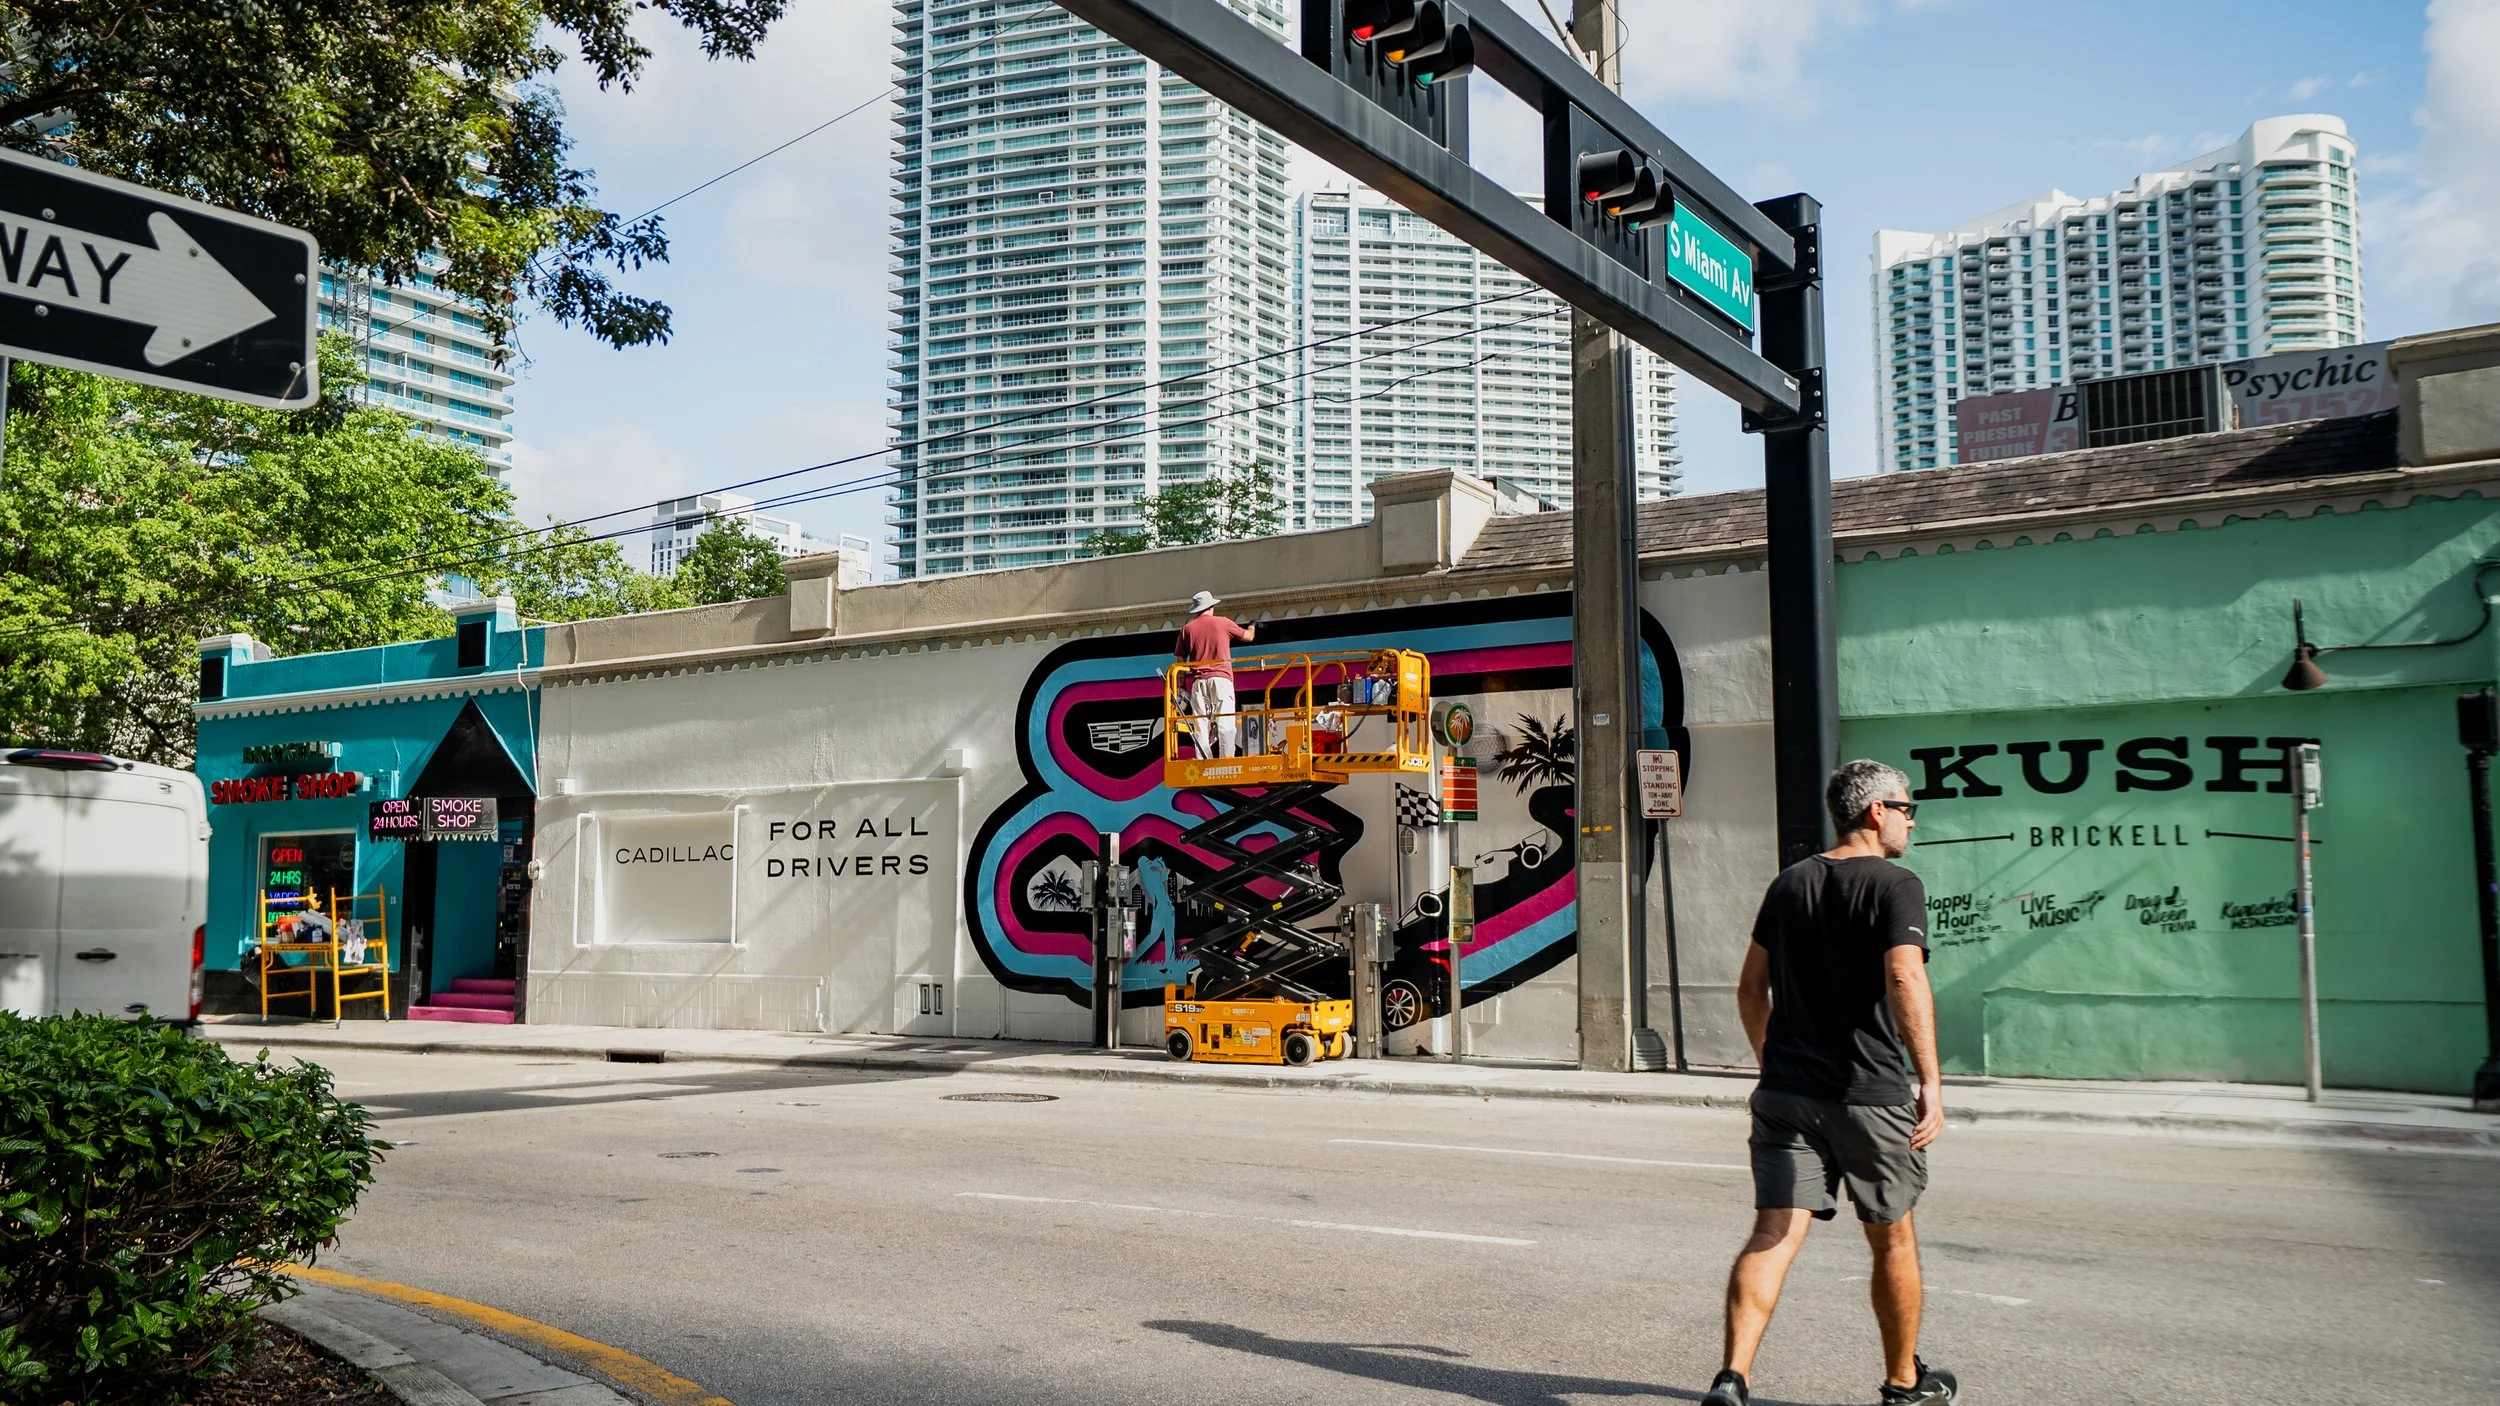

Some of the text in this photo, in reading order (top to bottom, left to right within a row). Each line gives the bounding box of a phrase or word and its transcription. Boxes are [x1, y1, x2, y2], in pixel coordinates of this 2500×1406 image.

[1670, 221, 1750, 307] S Miami Av
[2223, 354, 2378, 399] Psychic
[1977, 407, 2023, 425] PAST
[1963, 423, 2040, 444] PRESENT
[1969, 441, 2036, 460] FUTURE
[242, 740, 329, 764] BRICKELL
[1652, 754, 1663, 764] NO
[1202, 764, 1242, 777] SUNBELT
[1408, 757, 1423, 767] JCB
[1909, 736, 2321, 800] KUSH
[210, 771, 357, 804] SMOKE SHOP
[1642, 781, 1677, 789] STANDING
[382, 800, 410, 813] OPEN
[432, 799, 482, 812] SMOKE
[373, 815, 418, 829] 24 HOURS
[438, 814, 477, 827] SHOP
[769, 816, 929, 841] FOR ALL
[2029, 824, 2190, 848] BRICKELL
[271, 848, 303, 862] OPEN
[615, 844, 734, 865] CADILLAC
[767, 853, 929, 878] DRIVERS
[270, 870, 301, 885] 24 HRS
[2021, 894, 2056, 914] LIVE
[2124, 894, 2162, 912] Drag
[1937, 910, 1980, 930] Hour
[2029, 906, 2080, 929] MUSIC
[2139, 908, 2188, 926] Queen
